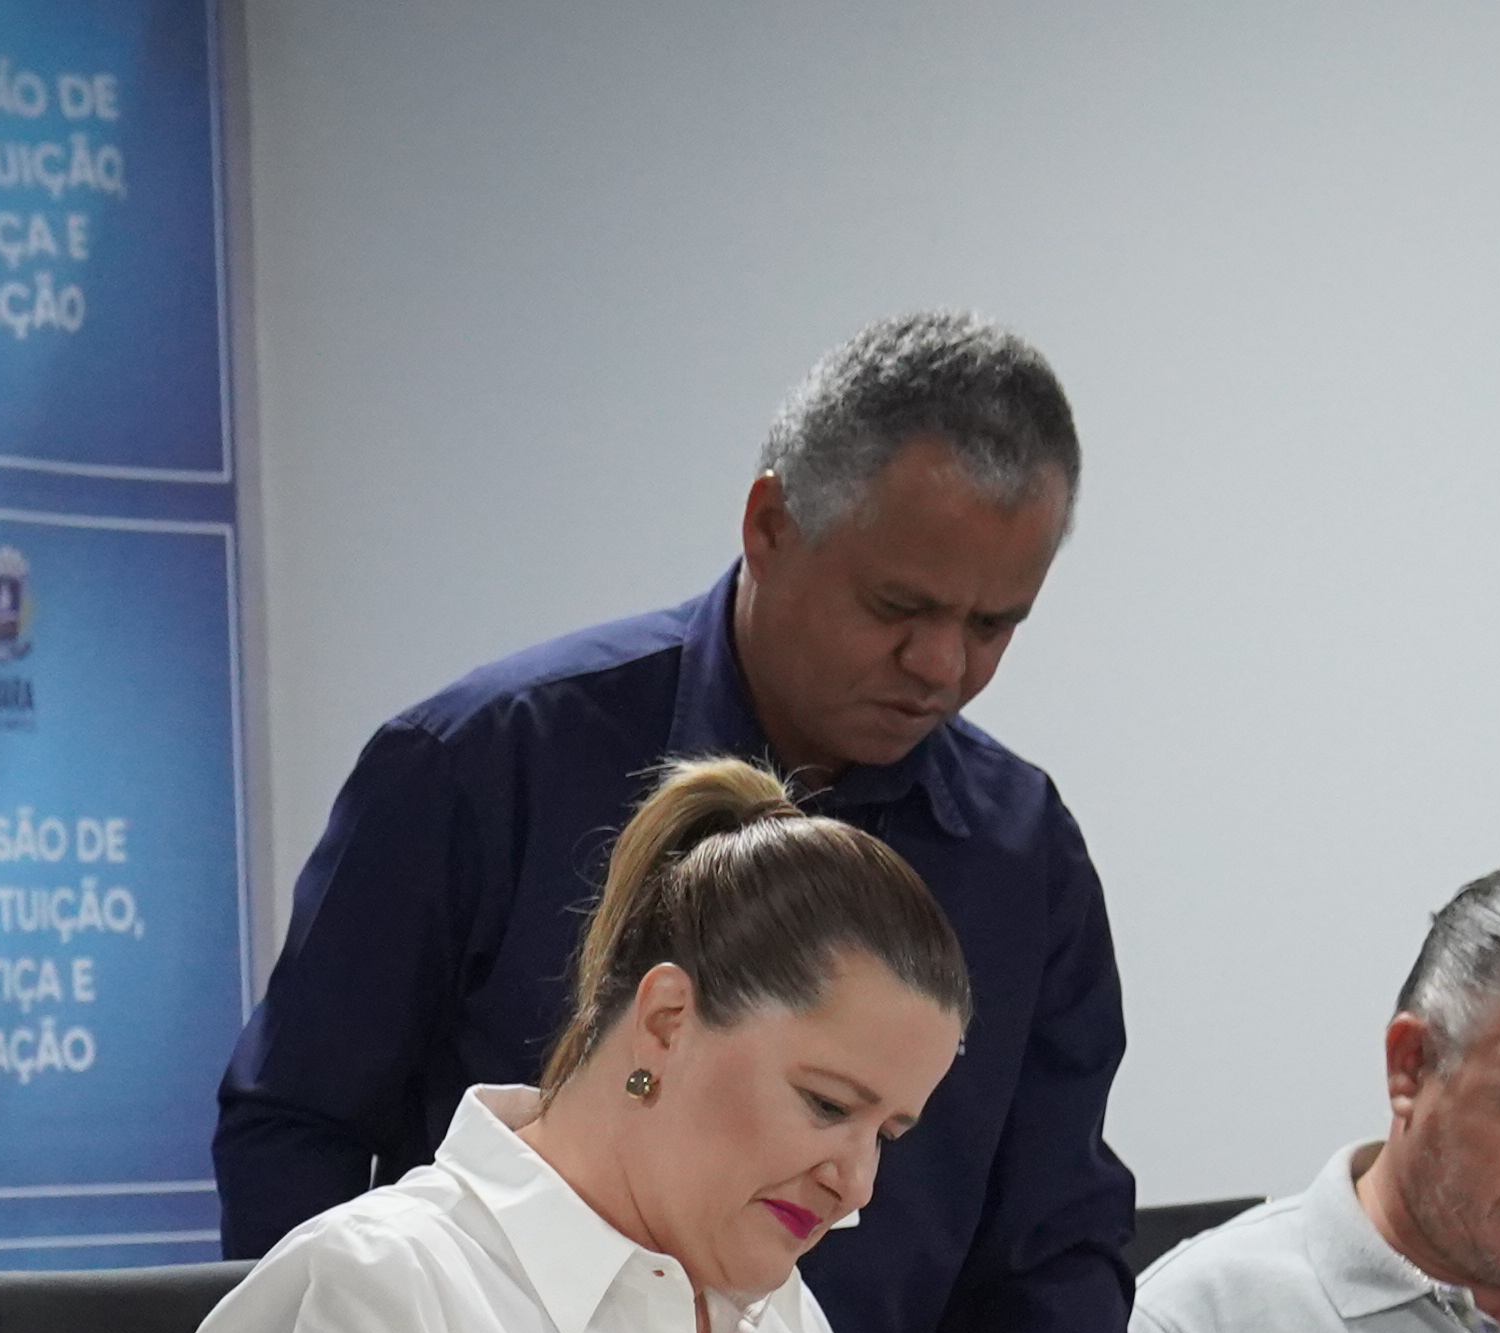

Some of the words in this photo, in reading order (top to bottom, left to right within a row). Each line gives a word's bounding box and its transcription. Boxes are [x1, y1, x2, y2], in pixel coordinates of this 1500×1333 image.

[56, 73, 120, 121] DE
[66, 213, 90, 262] E
[77, 818, 128, 863] DE
[72, 959, 95, 1001] E
